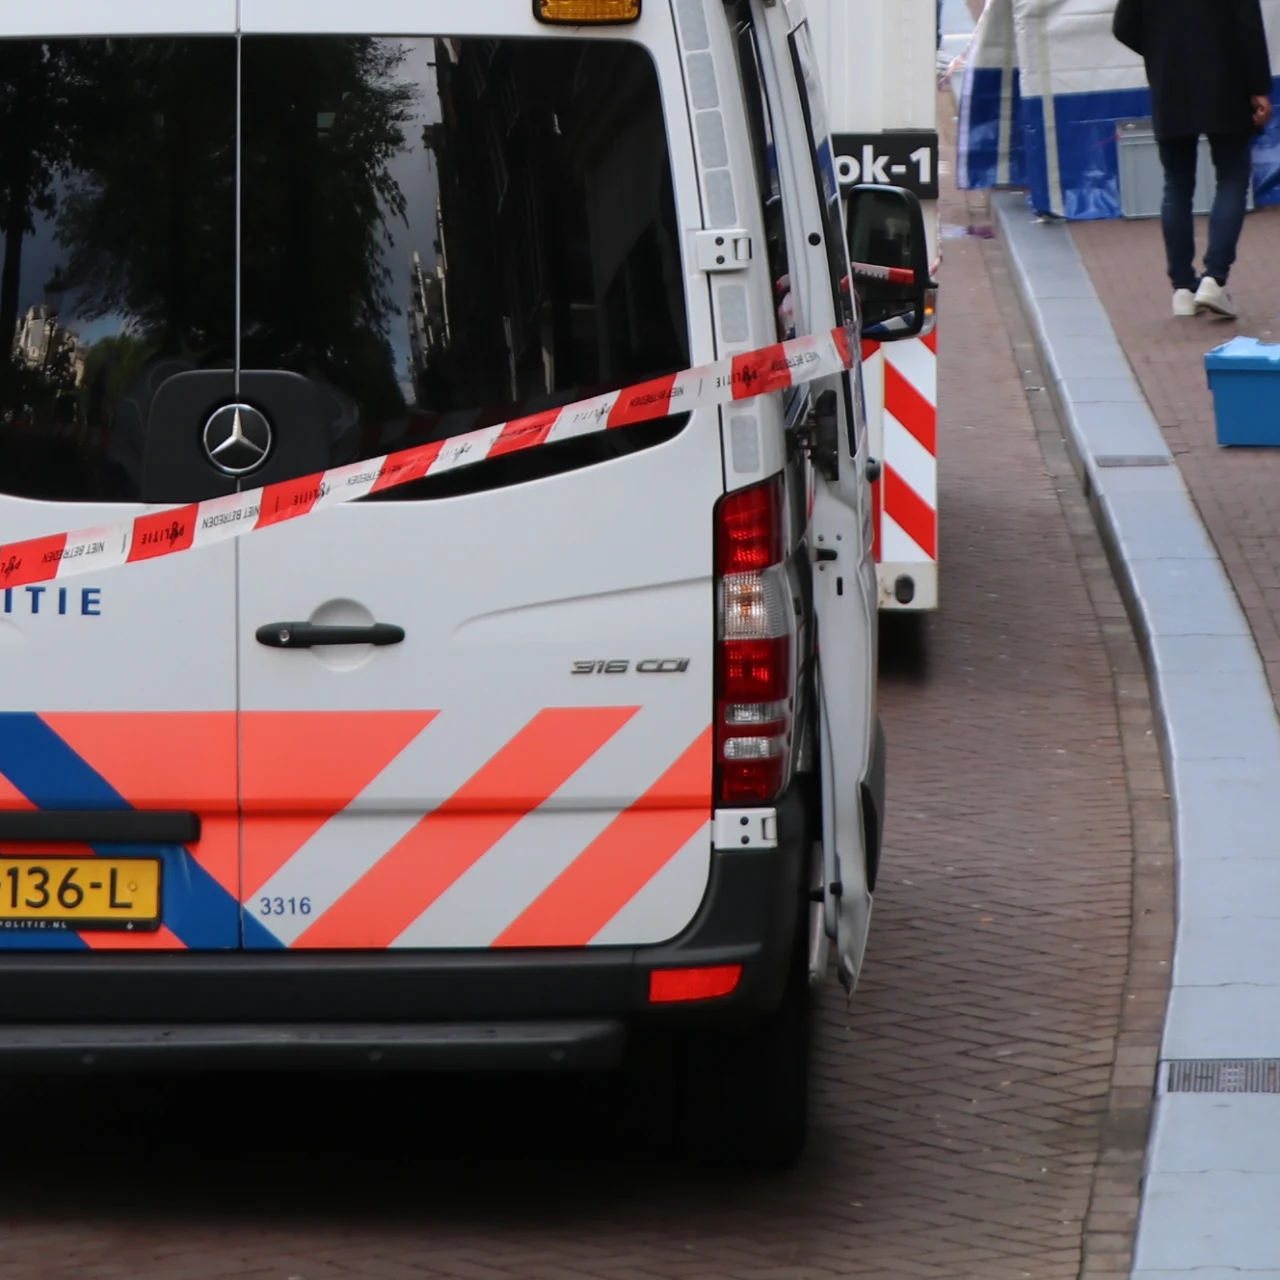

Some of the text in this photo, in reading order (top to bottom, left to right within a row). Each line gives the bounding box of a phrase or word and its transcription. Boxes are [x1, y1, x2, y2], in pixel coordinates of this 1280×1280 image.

[201, 509, 243, 529] BETREDEN
[42, 544, 86, 564] BETREDEN
[570, 658, 690, 674] 316 CDI
[260, 896, 312, 915] 3316
